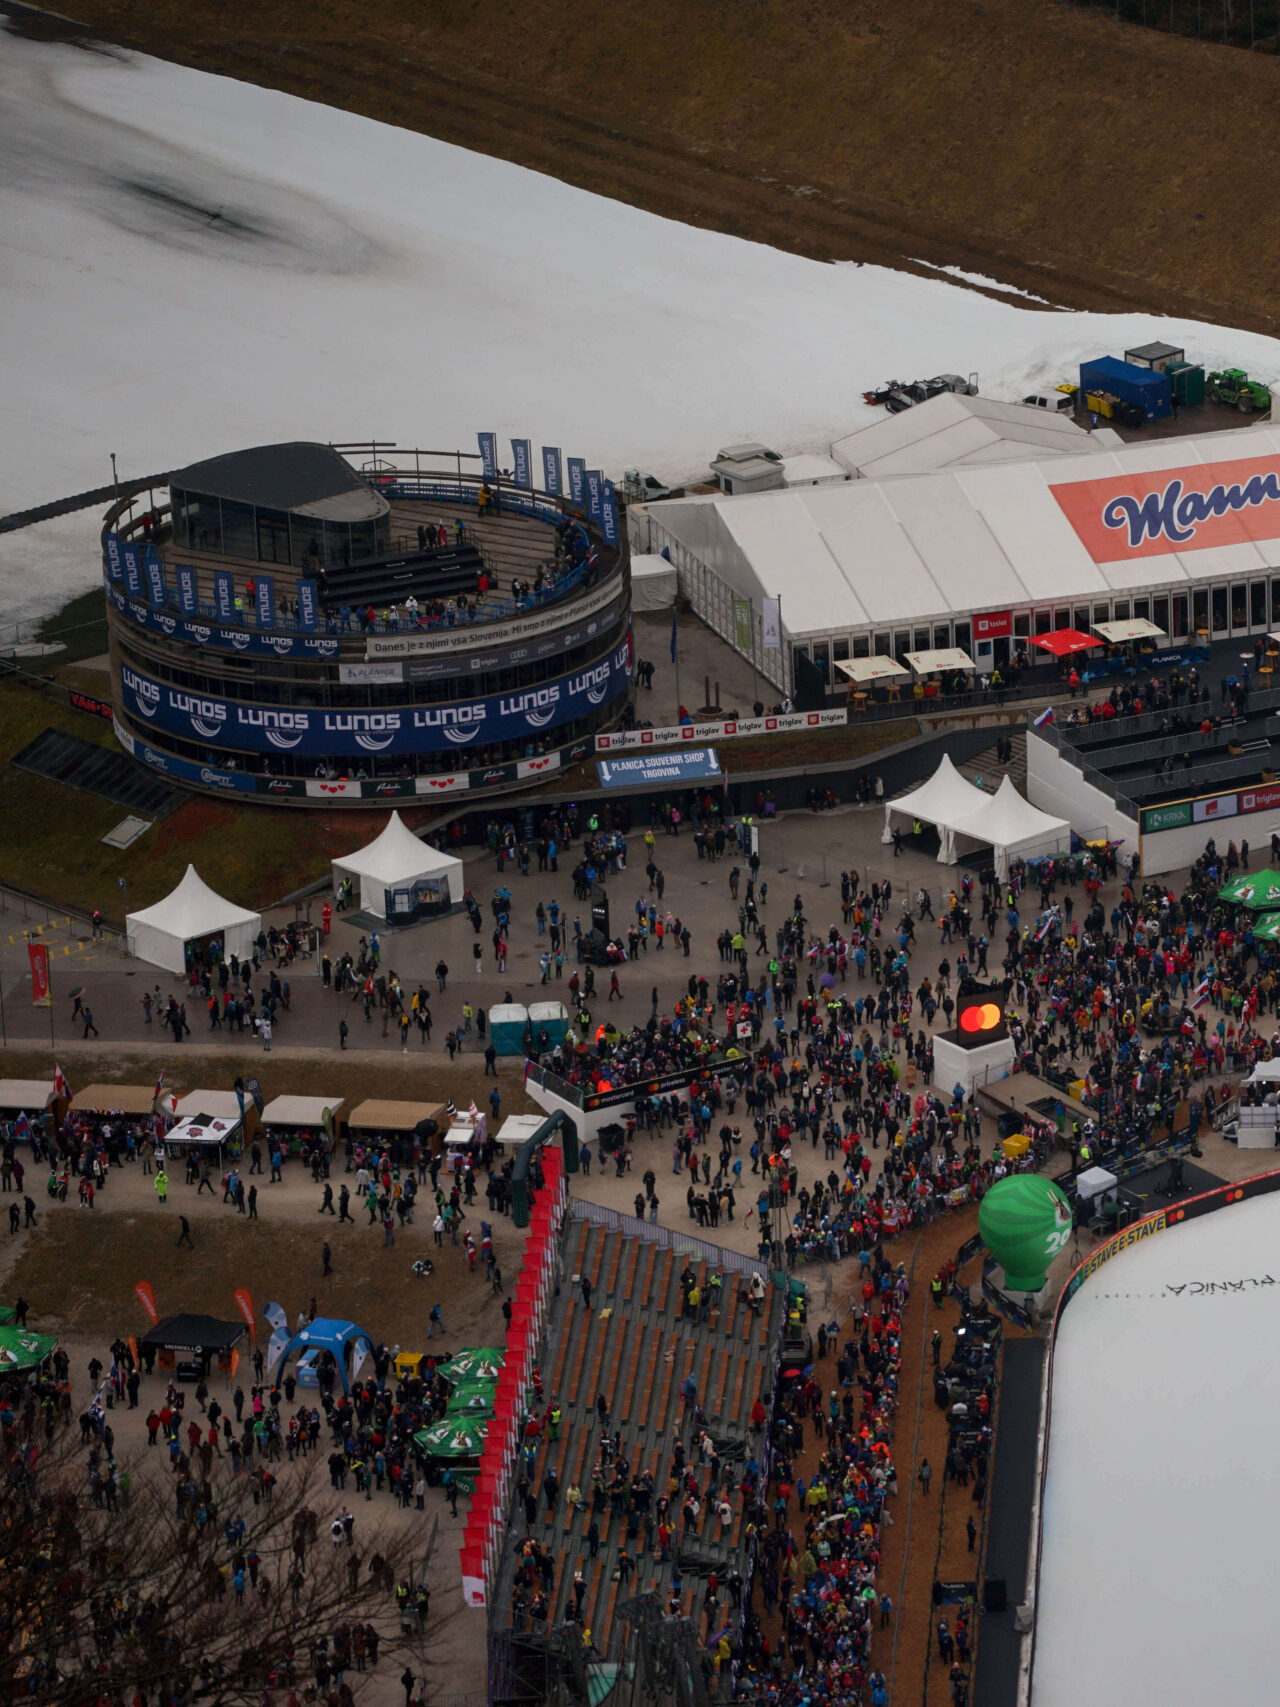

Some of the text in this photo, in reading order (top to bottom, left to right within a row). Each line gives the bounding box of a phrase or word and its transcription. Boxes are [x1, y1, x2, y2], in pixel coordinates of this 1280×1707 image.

[375, 641, 405, 652] Danes
[451, 637, 467, 646] vsa
[1151, 654, 1182, 663] PLANICA
[122, 667, 160, 702] LUNOS
[568, 661, 610, 695] LUNOS
[169, 691, 227, 720] LUNOS
[500, 685, 560, 715] LUNOS
[238, 707, 309, 729] LUNOS
[325, 713, 401, 730] LUNOS
[414, 704, 486, 727] LUNOS
[612, 712, 845, 746] triglav triglav triglav triglav triglav triglav
[611, 752, 704, 771] PLANICA SOUVENIR SHOP
[642, 767, 681, 779] TRGOVINA
[1256, 791, 1280, 804] triglav
[1163, 809, 1186, 824] KRKA
[600, 1090, 635, 1103] mastercard
[661, 1077, 686, 1089] priceless
[1119, 1214, 1165, 1252] E-STAVE
[1166, 1274, 1276, 1295] PLANICA
[164, 1343, 195, 1353] MERRELL
